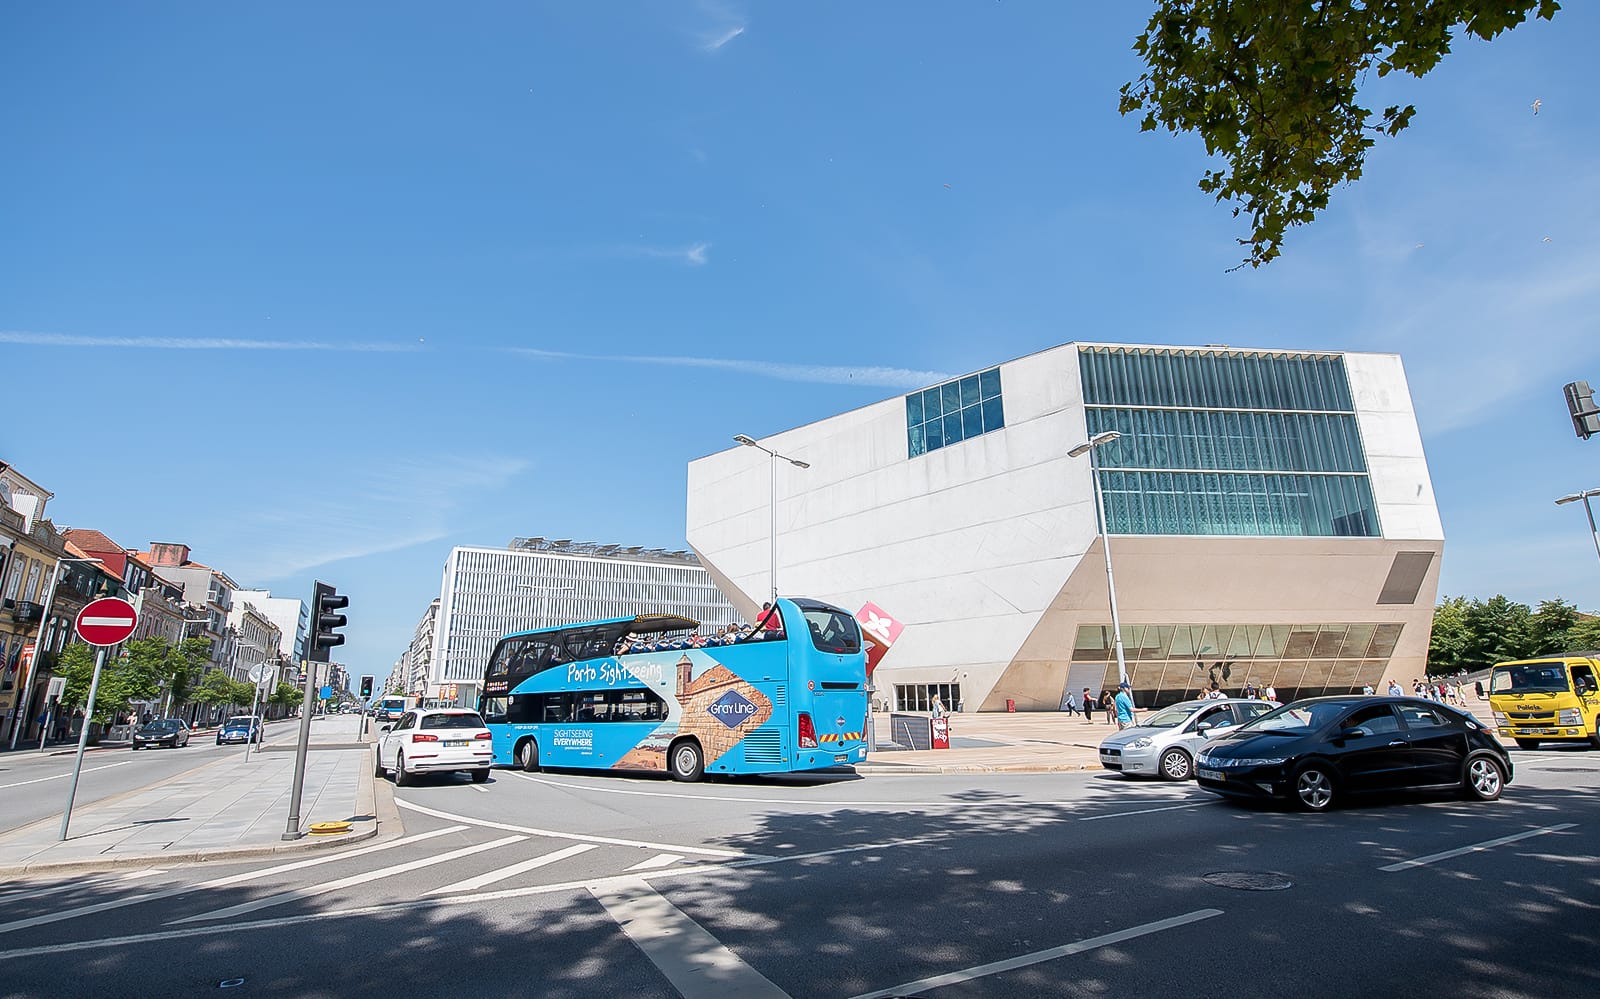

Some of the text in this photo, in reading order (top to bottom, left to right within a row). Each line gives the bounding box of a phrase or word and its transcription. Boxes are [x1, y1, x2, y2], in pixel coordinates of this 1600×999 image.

[567, 660, 663, 685] Porto Sightseeing
[710, 703, 734, 715] Gray
[553, 729, 593, 739] SIGHTSEEING
[553, 738, 593, 747] EVERYWHERE
